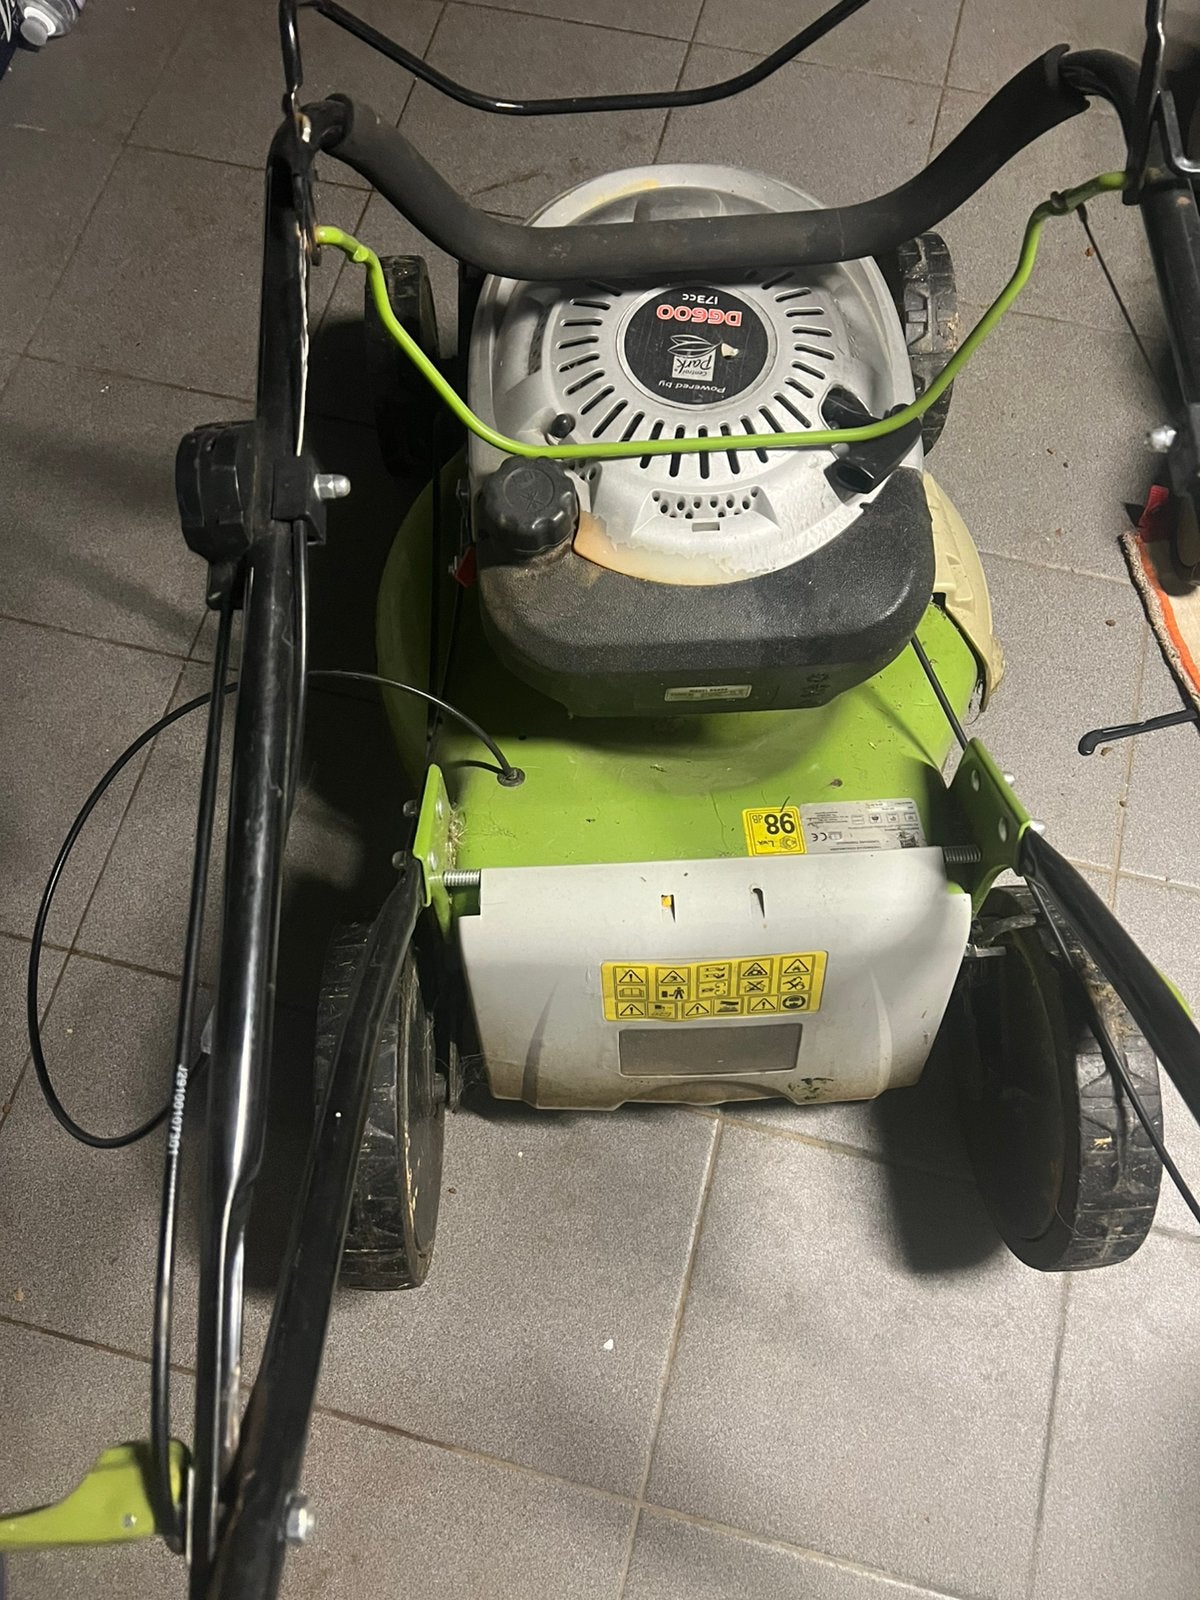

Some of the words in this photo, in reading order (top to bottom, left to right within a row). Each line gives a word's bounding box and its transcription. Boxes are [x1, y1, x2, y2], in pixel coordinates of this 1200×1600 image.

[682, 293, 718, 305] 173cc
[656, 304, 742, 327] DG600
[658, 379, 673, 389] by
[675, 382, 726, 394] Powered
[752, 814, 763, 824] dB
[764, 813, 796, 835] 98
